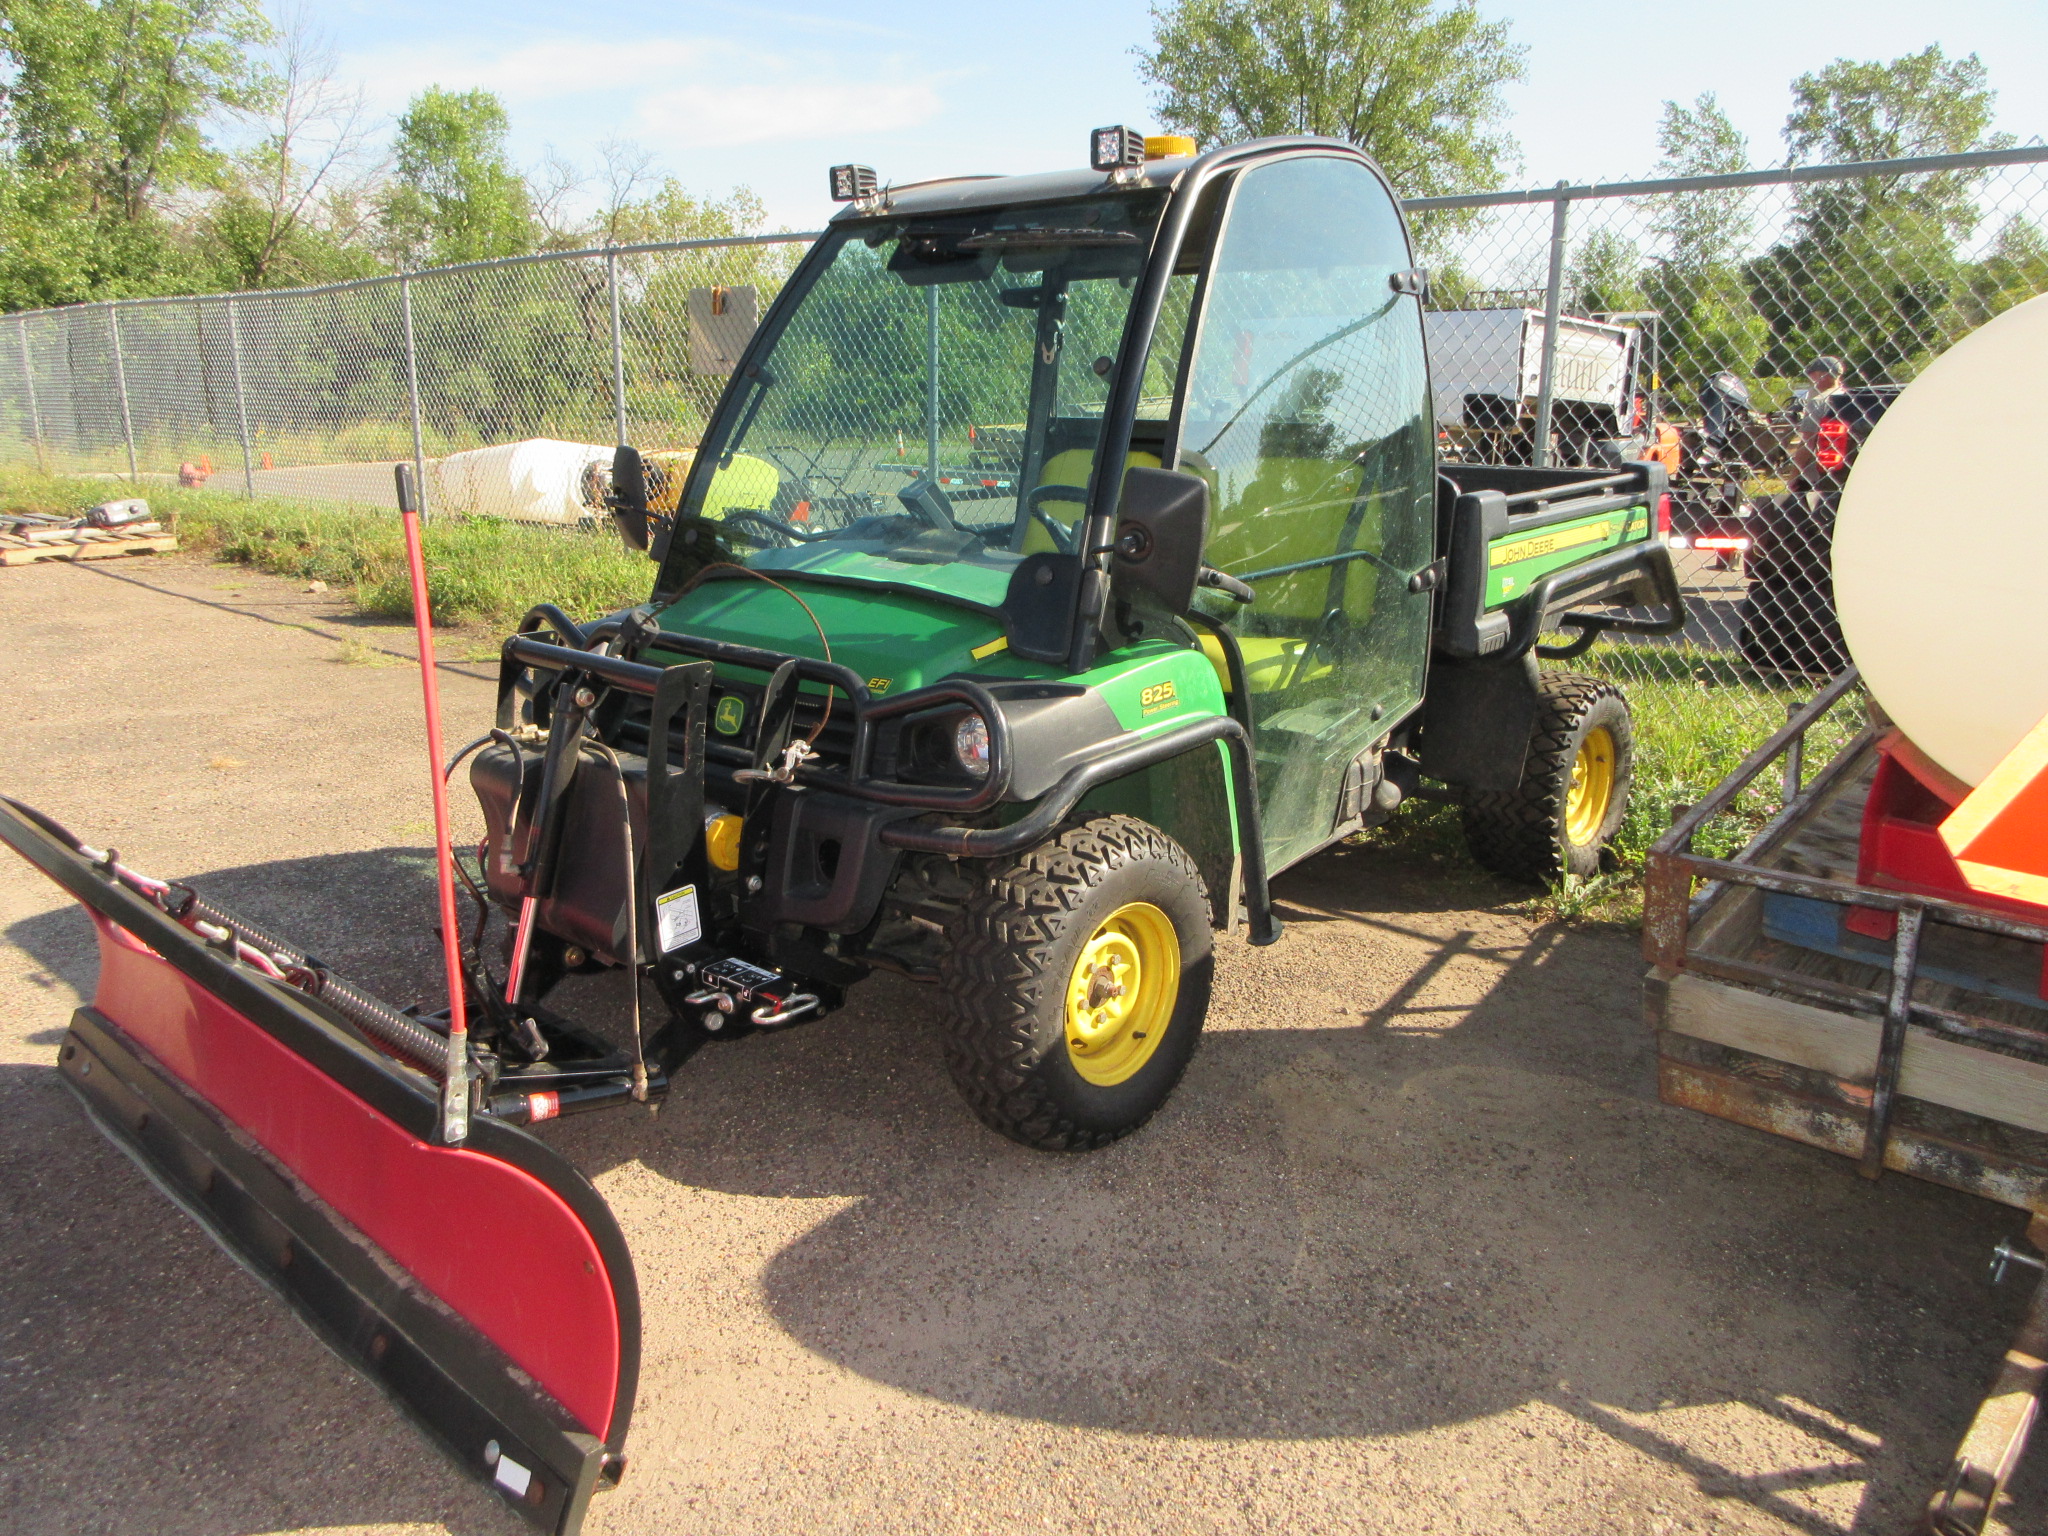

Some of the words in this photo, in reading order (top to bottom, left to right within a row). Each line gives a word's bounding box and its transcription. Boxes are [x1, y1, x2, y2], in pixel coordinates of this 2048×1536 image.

[1502, 545, 1526, 563] JOHN
[1527, 539, 1554, 557] DEERE
[867, 677, 891, 689] EFI
